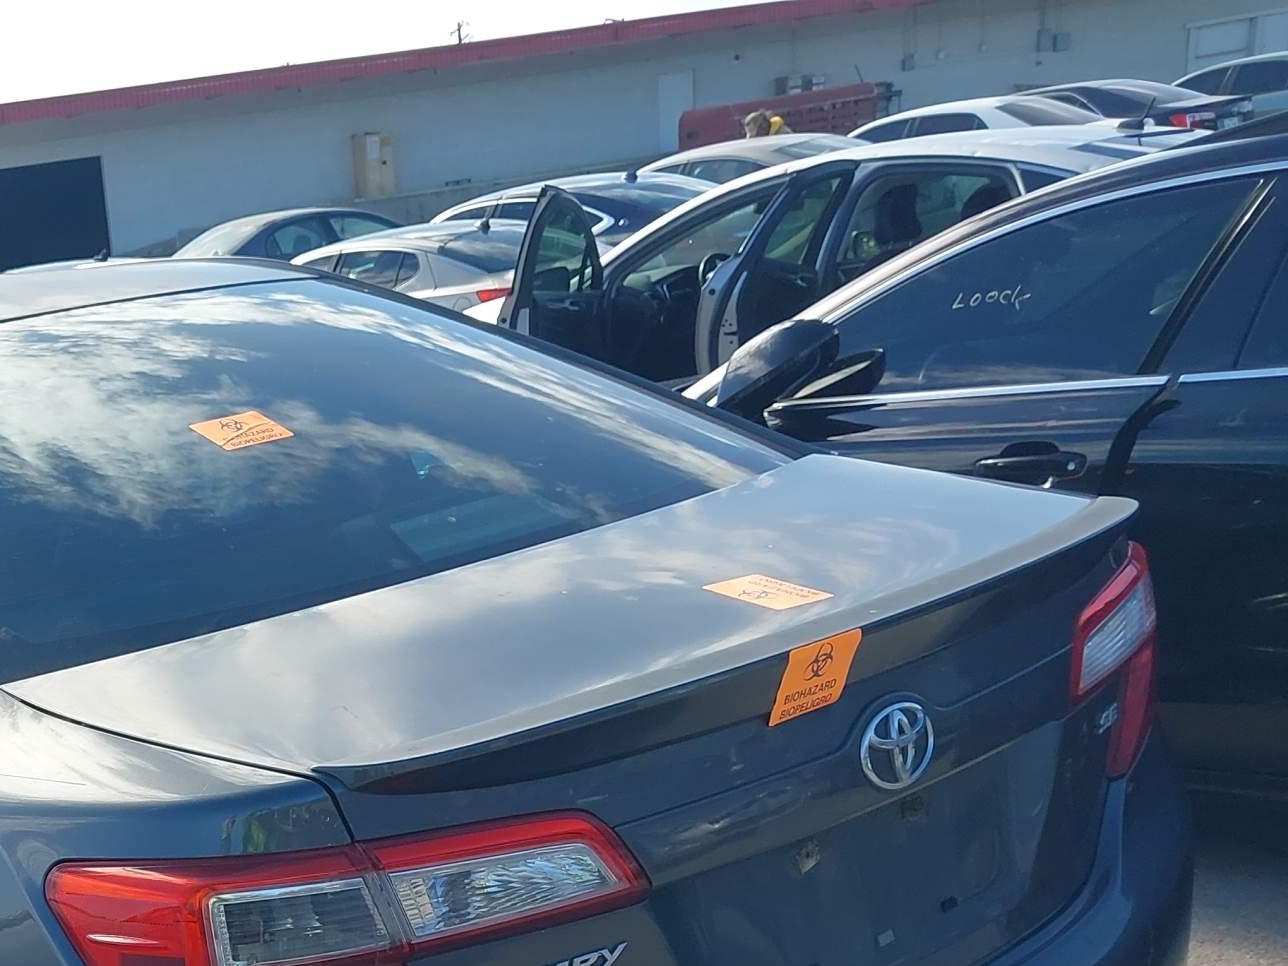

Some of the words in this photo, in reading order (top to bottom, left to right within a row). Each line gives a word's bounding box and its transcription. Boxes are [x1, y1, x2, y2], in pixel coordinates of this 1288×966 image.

[783, 678, 838, 705] BIOHAZARD
[779, 693, 834, 720] BIOPELIGRO
[1098, 702, 1118, 735] SE
